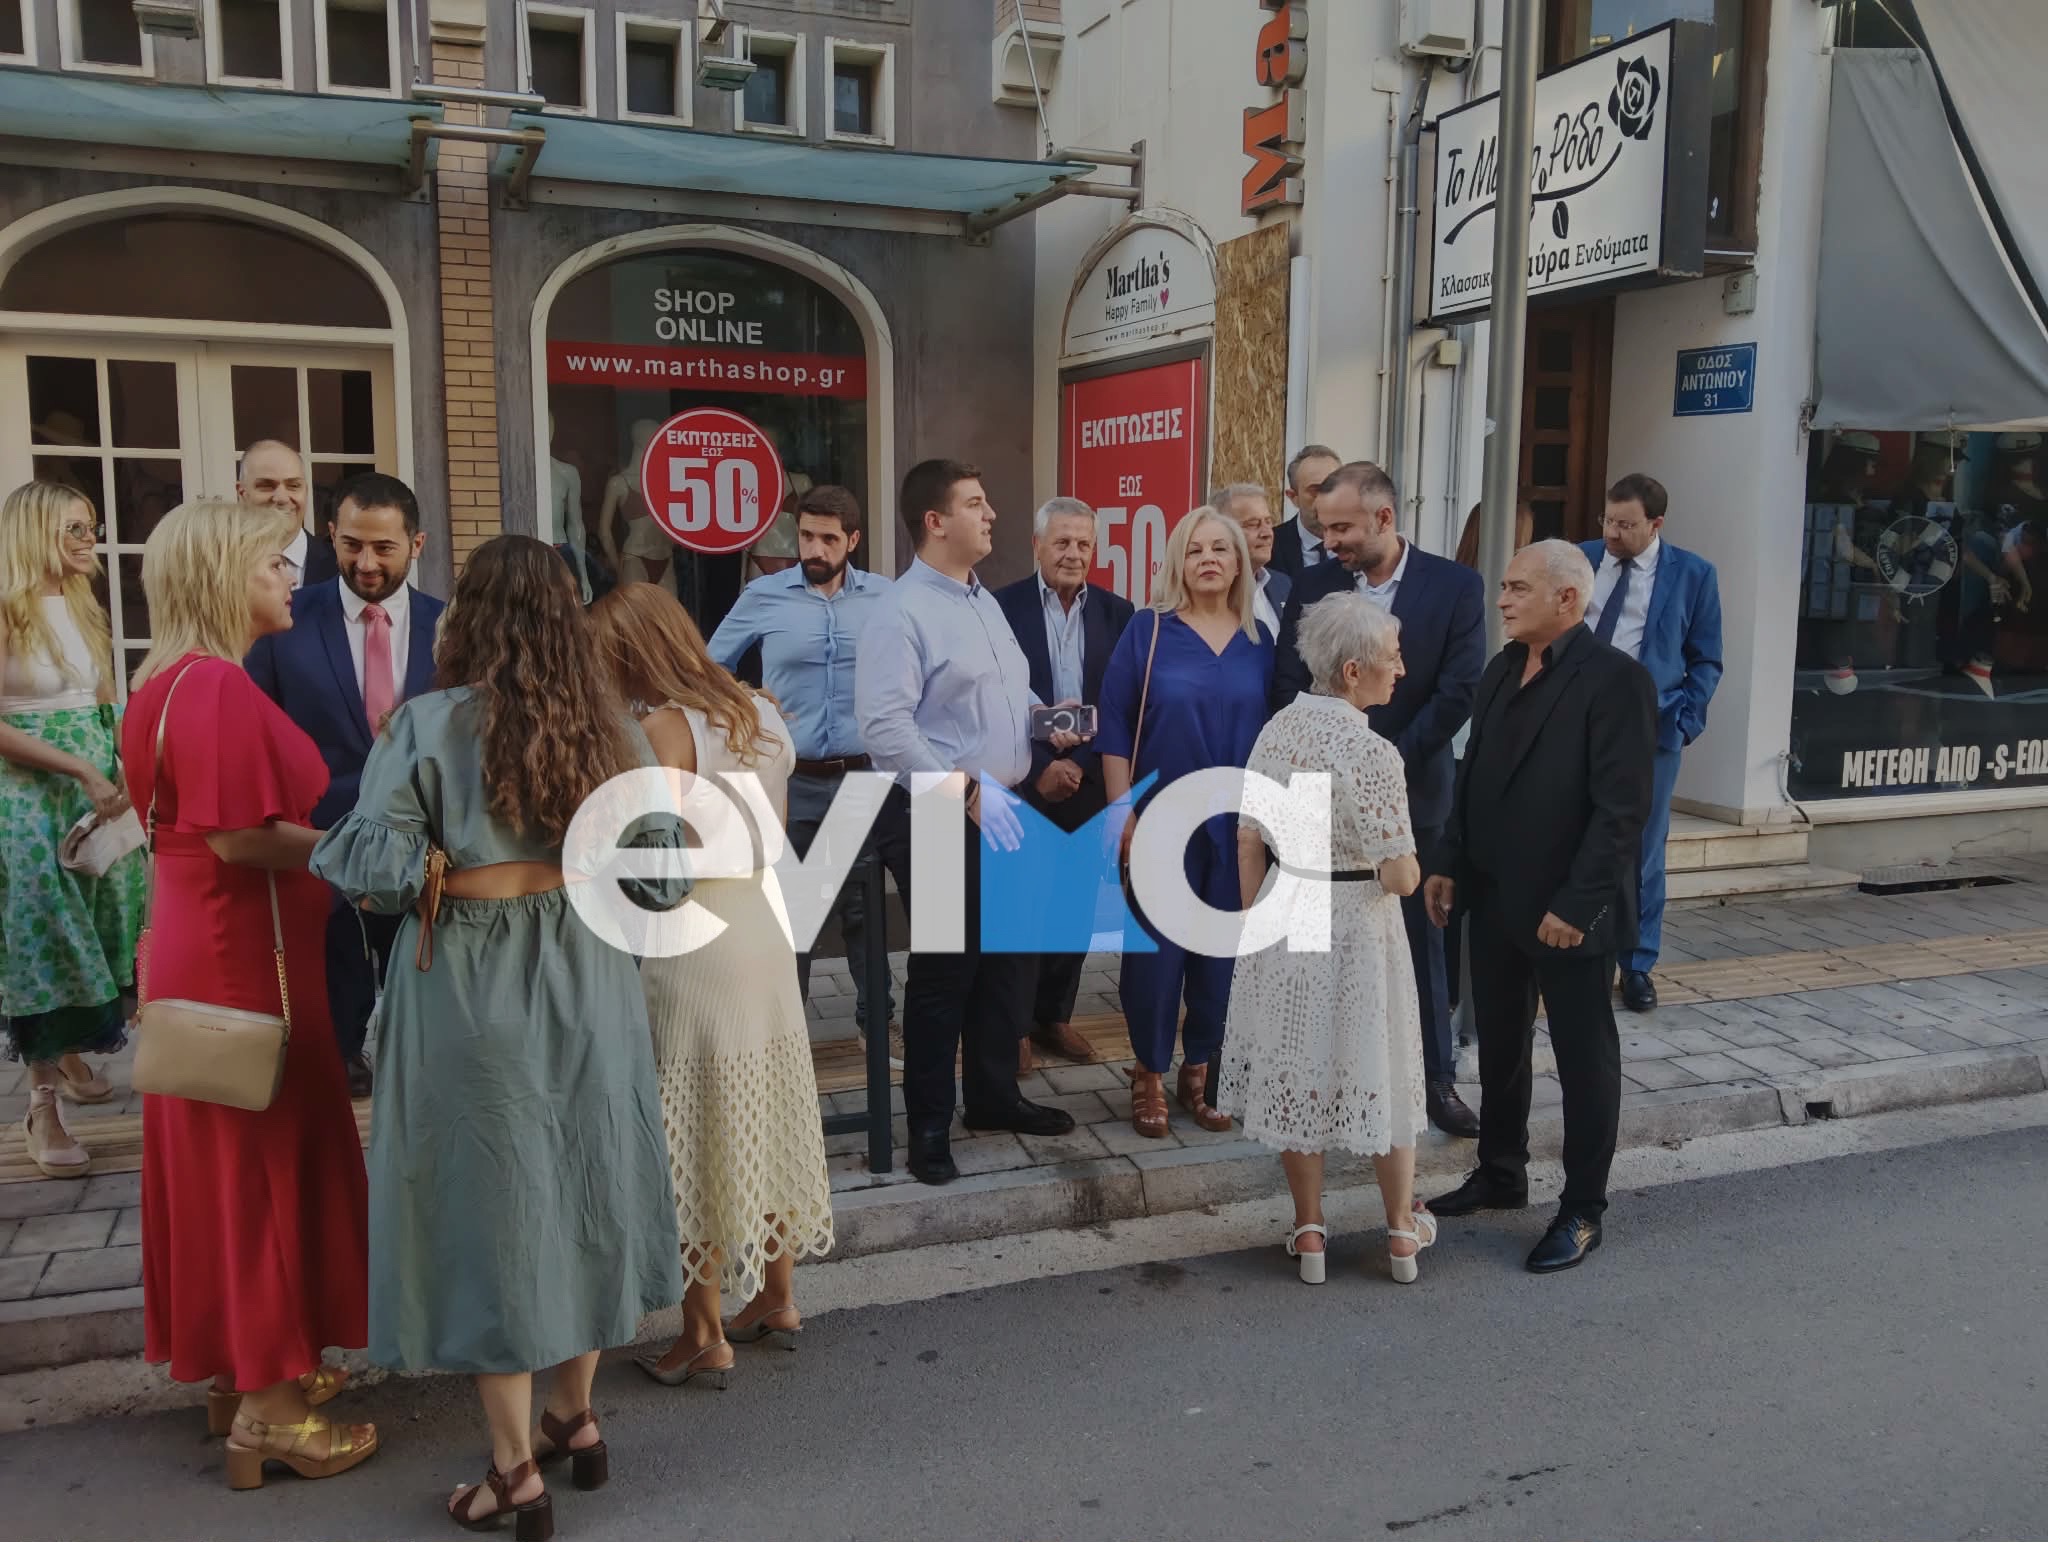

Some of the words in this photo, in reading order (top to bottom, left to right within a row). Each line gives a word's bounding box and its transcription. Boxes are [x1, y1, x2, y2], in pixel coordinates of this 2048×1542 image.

[1440, 272, 1493, 298] Κλασσικ
[1575, 233, 1649, 267] Ενδύματα
[654, 288, 735, 315] SHOP
[1105, 304, 1129, 322] Happy
[1131, 293, 1158, 315] Family
[655, 316, 764, 345] ONLINE
[566, 355, 846, 387] www.marthashop.gr
[1697, 353, 1734, 370] ΟΔΟΣ
[1681, 369, 1747, 392] ΑΝΤΩΝΙΟΥ
[1703, 392, 1718, 407] 31
[666, 429, 758, 449] ΕΚΠΤΩΣΕΙΣ
[1081, 407, 1183, 449] ΕΚΠΤΩΣΕΙΣ
[701, 447, 724, 457] ΕΩΣ
[1118, 475, 1143, 498] ΕΩΣ
[1841, 747, 1930, 788] ΜΕΓΕΘΗ
[1934, 745, 1981, 783] ΑΠΟ
